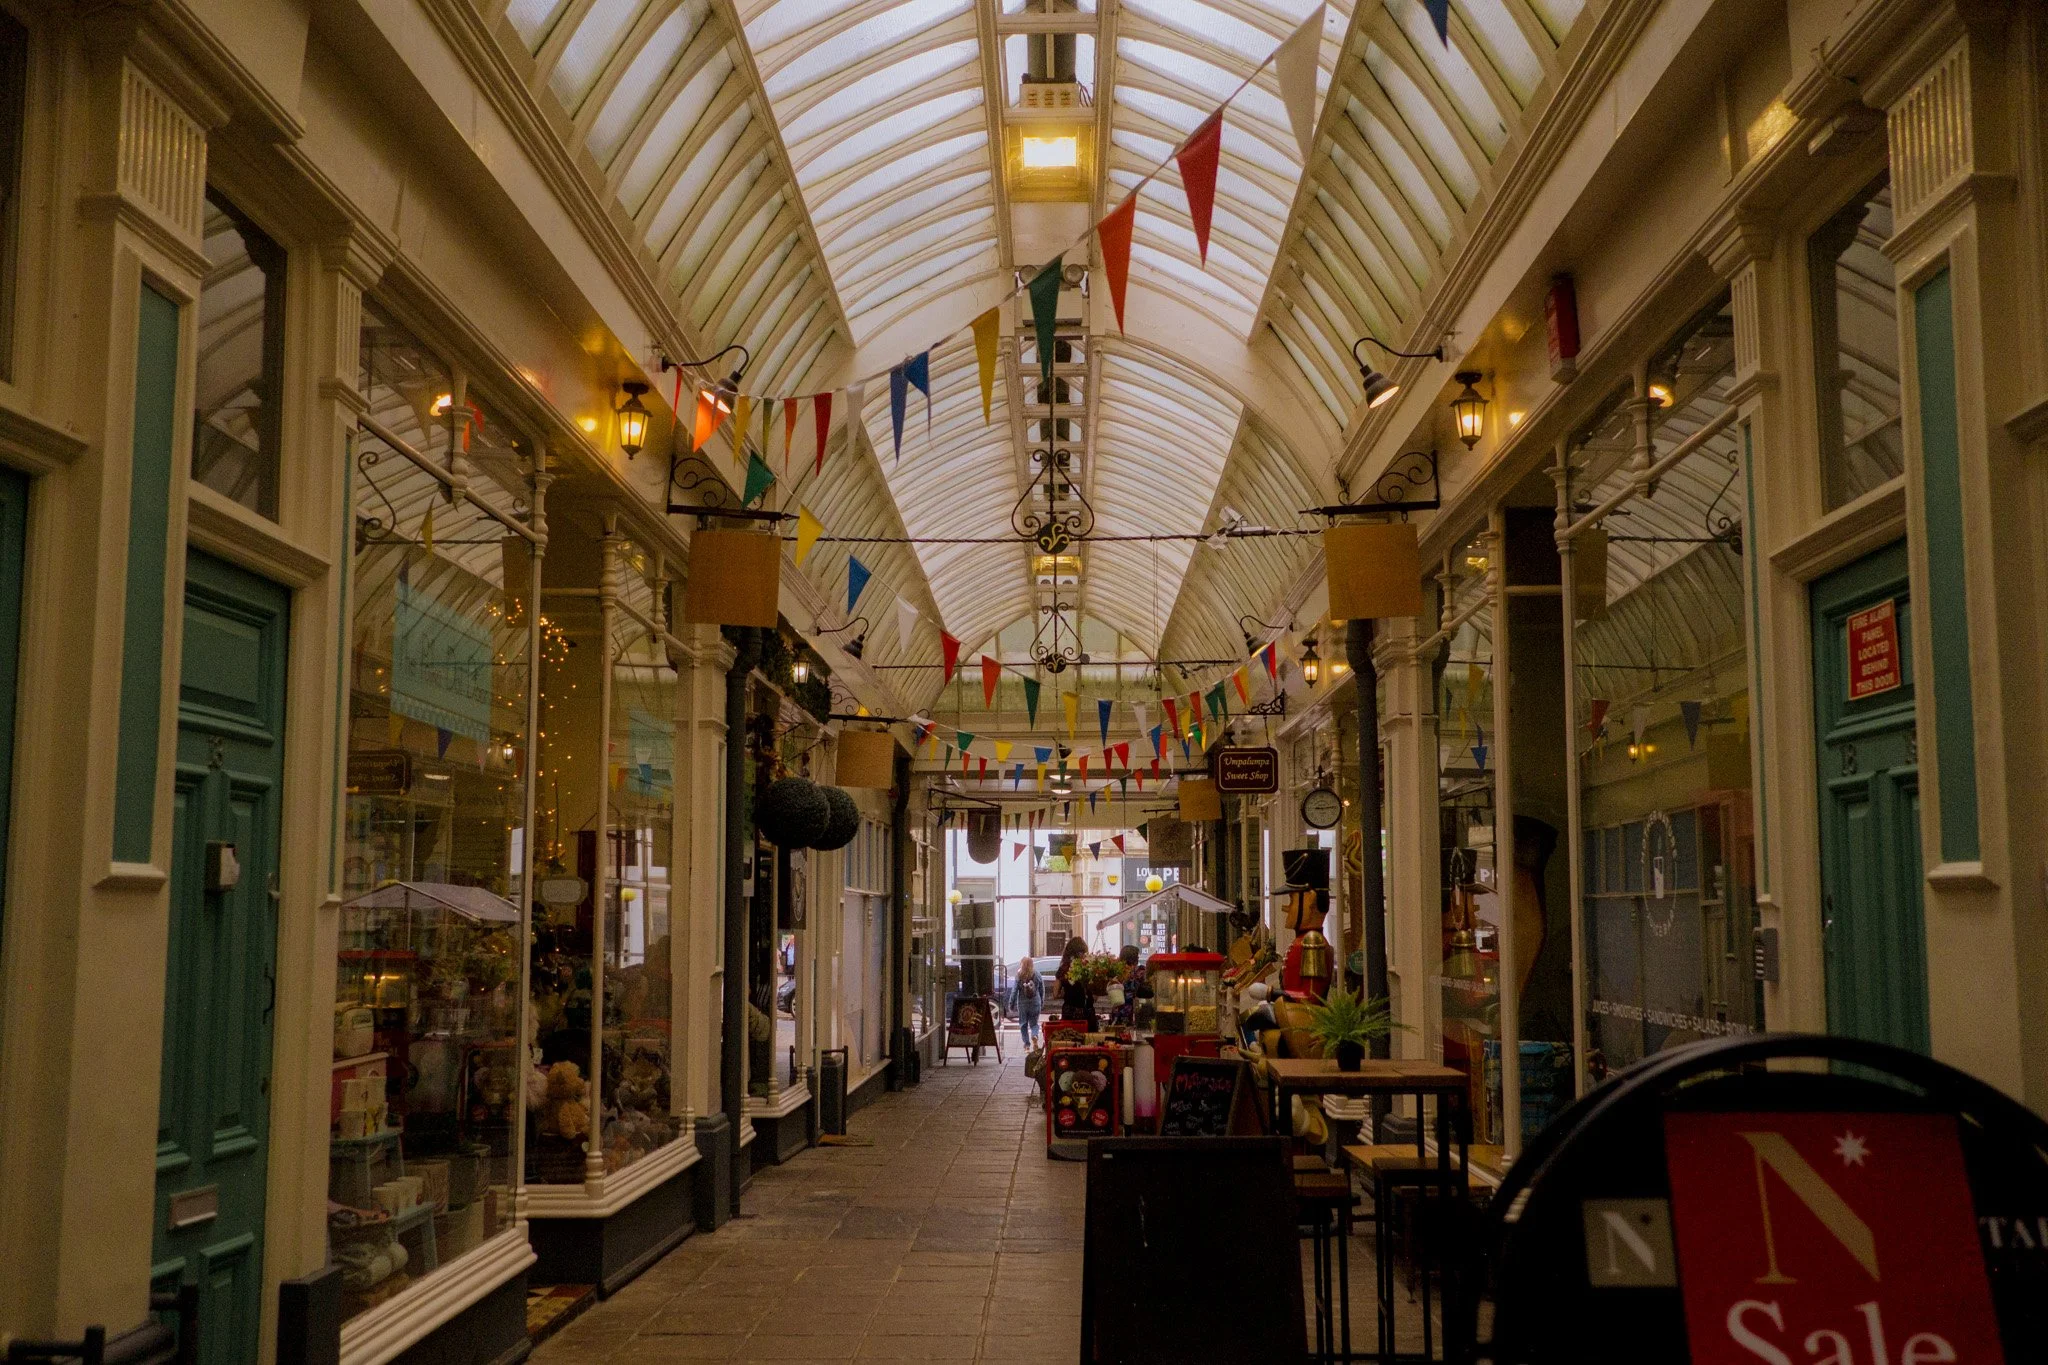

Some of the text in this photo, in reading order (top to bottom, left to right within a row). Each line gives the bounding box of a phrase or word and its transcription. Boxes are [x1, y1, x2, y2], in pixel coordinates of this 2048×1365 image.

[1857, 640, 1890, 661] LOCATED
[1856, 679, 1874, 694] THIS
[1224, 770, 1269, 782] Sweet Shop
[1136, 867, 1158, 877] LOV
[1612, 1002, 1643, 1021] SMOOTHIES
[1647, 1009, 1688, 1029] SANDWICHES
[1692, 1016, 1720, 1035] SALADS
[1736, 1132, 1881, 1284] N
[1601, 1211, 1656, 1275] N
